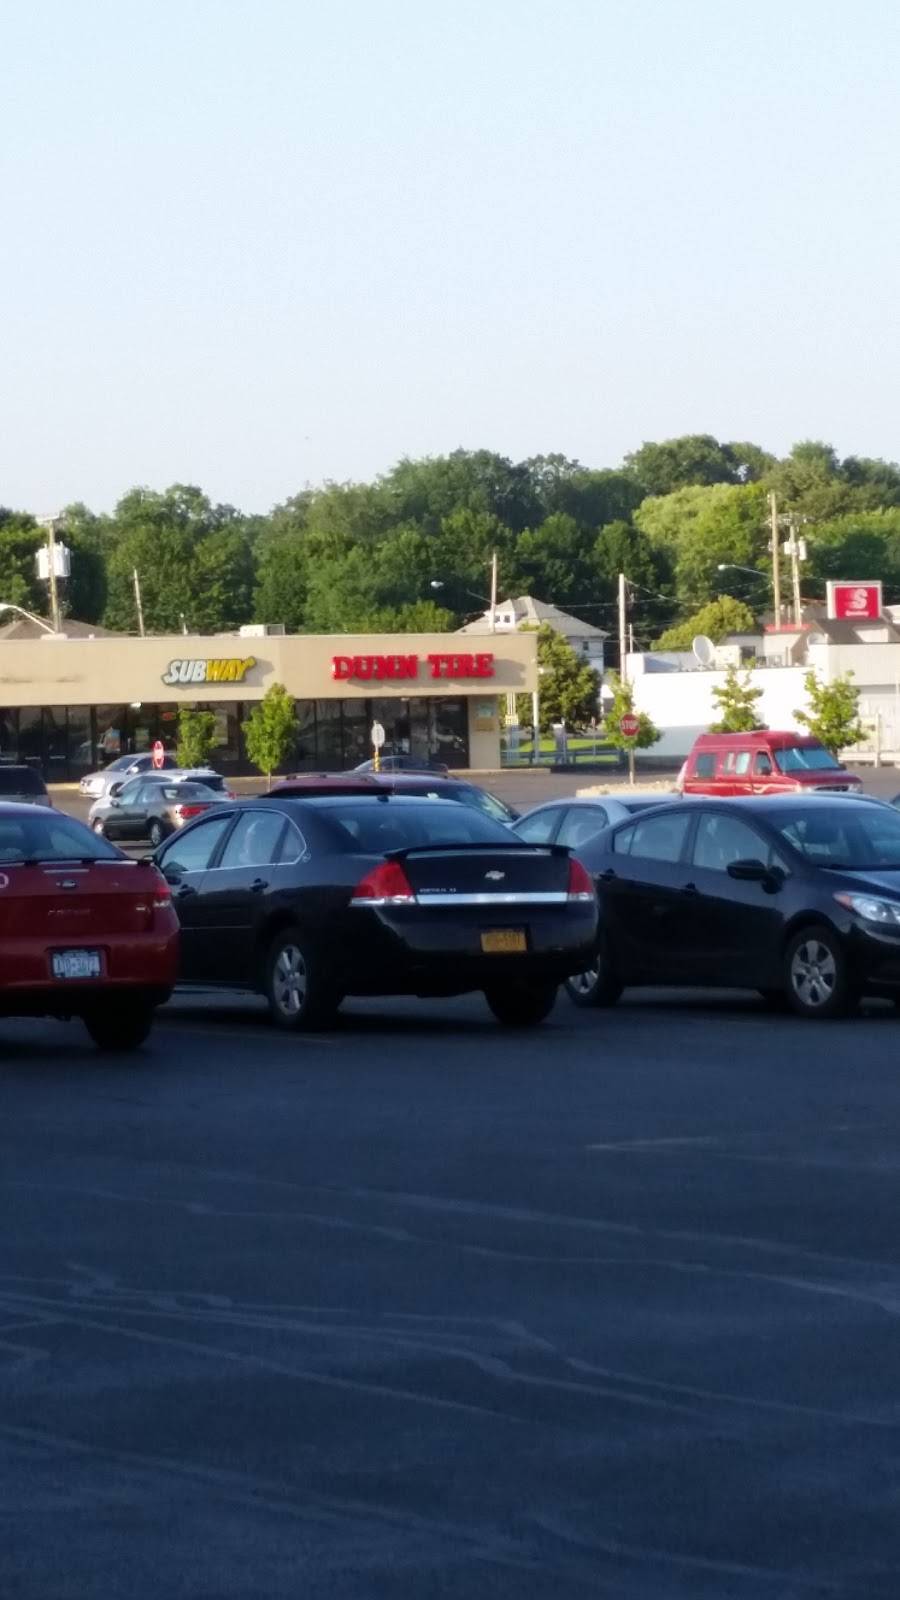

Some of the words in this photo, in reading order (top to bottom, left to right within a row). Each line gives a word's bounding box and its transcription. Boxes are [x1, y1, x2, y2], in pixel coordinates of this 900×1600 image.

[162, 657, 256, 685] SUBWAY
[332, 654, 418, 681] DUNN
[427, 653, 495, 679] TIRE
[620, 719, 638, 730] STOP
